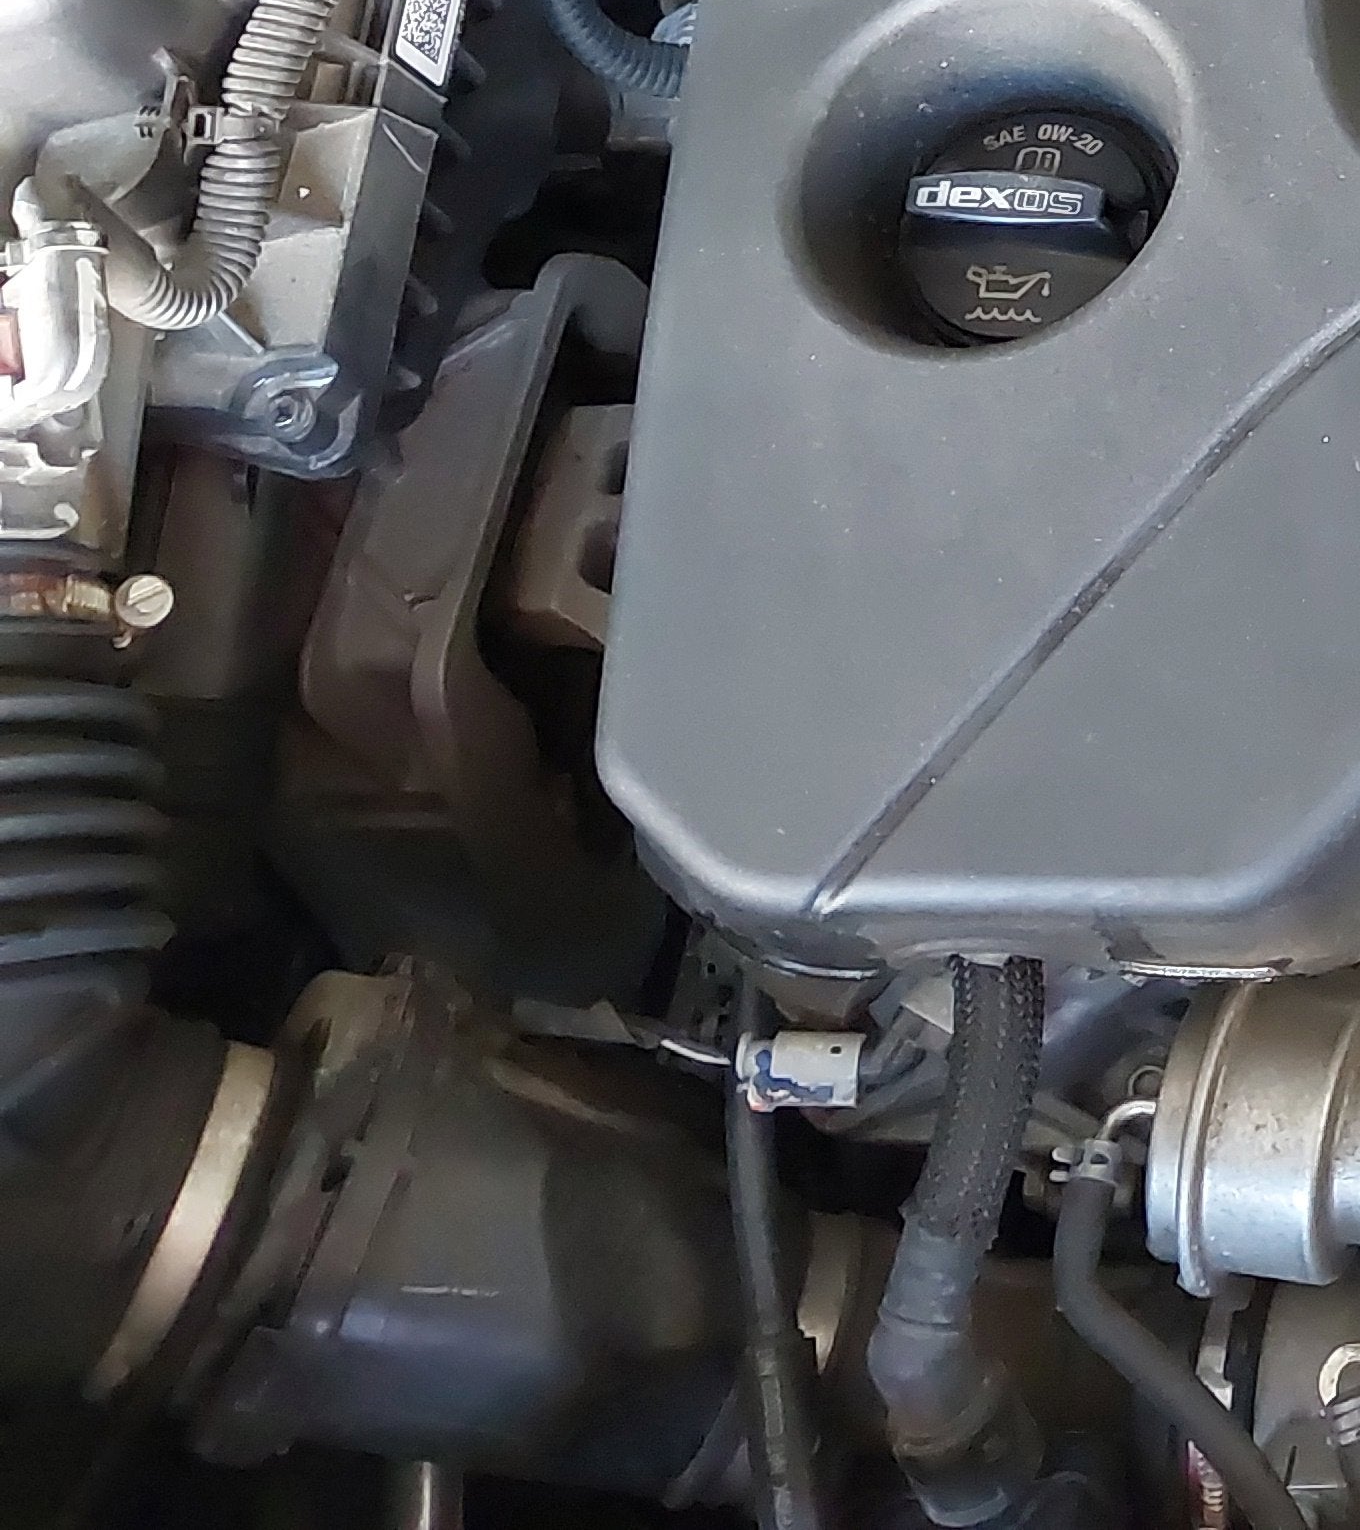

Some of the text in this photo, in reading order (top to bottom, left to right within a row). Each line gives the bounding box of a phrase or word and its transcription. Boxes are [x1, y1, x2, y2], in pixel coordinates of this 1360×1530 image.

[983, 123, 1104, 156] SAE 0W-20
[915, 179, 1083, 215] dexos
